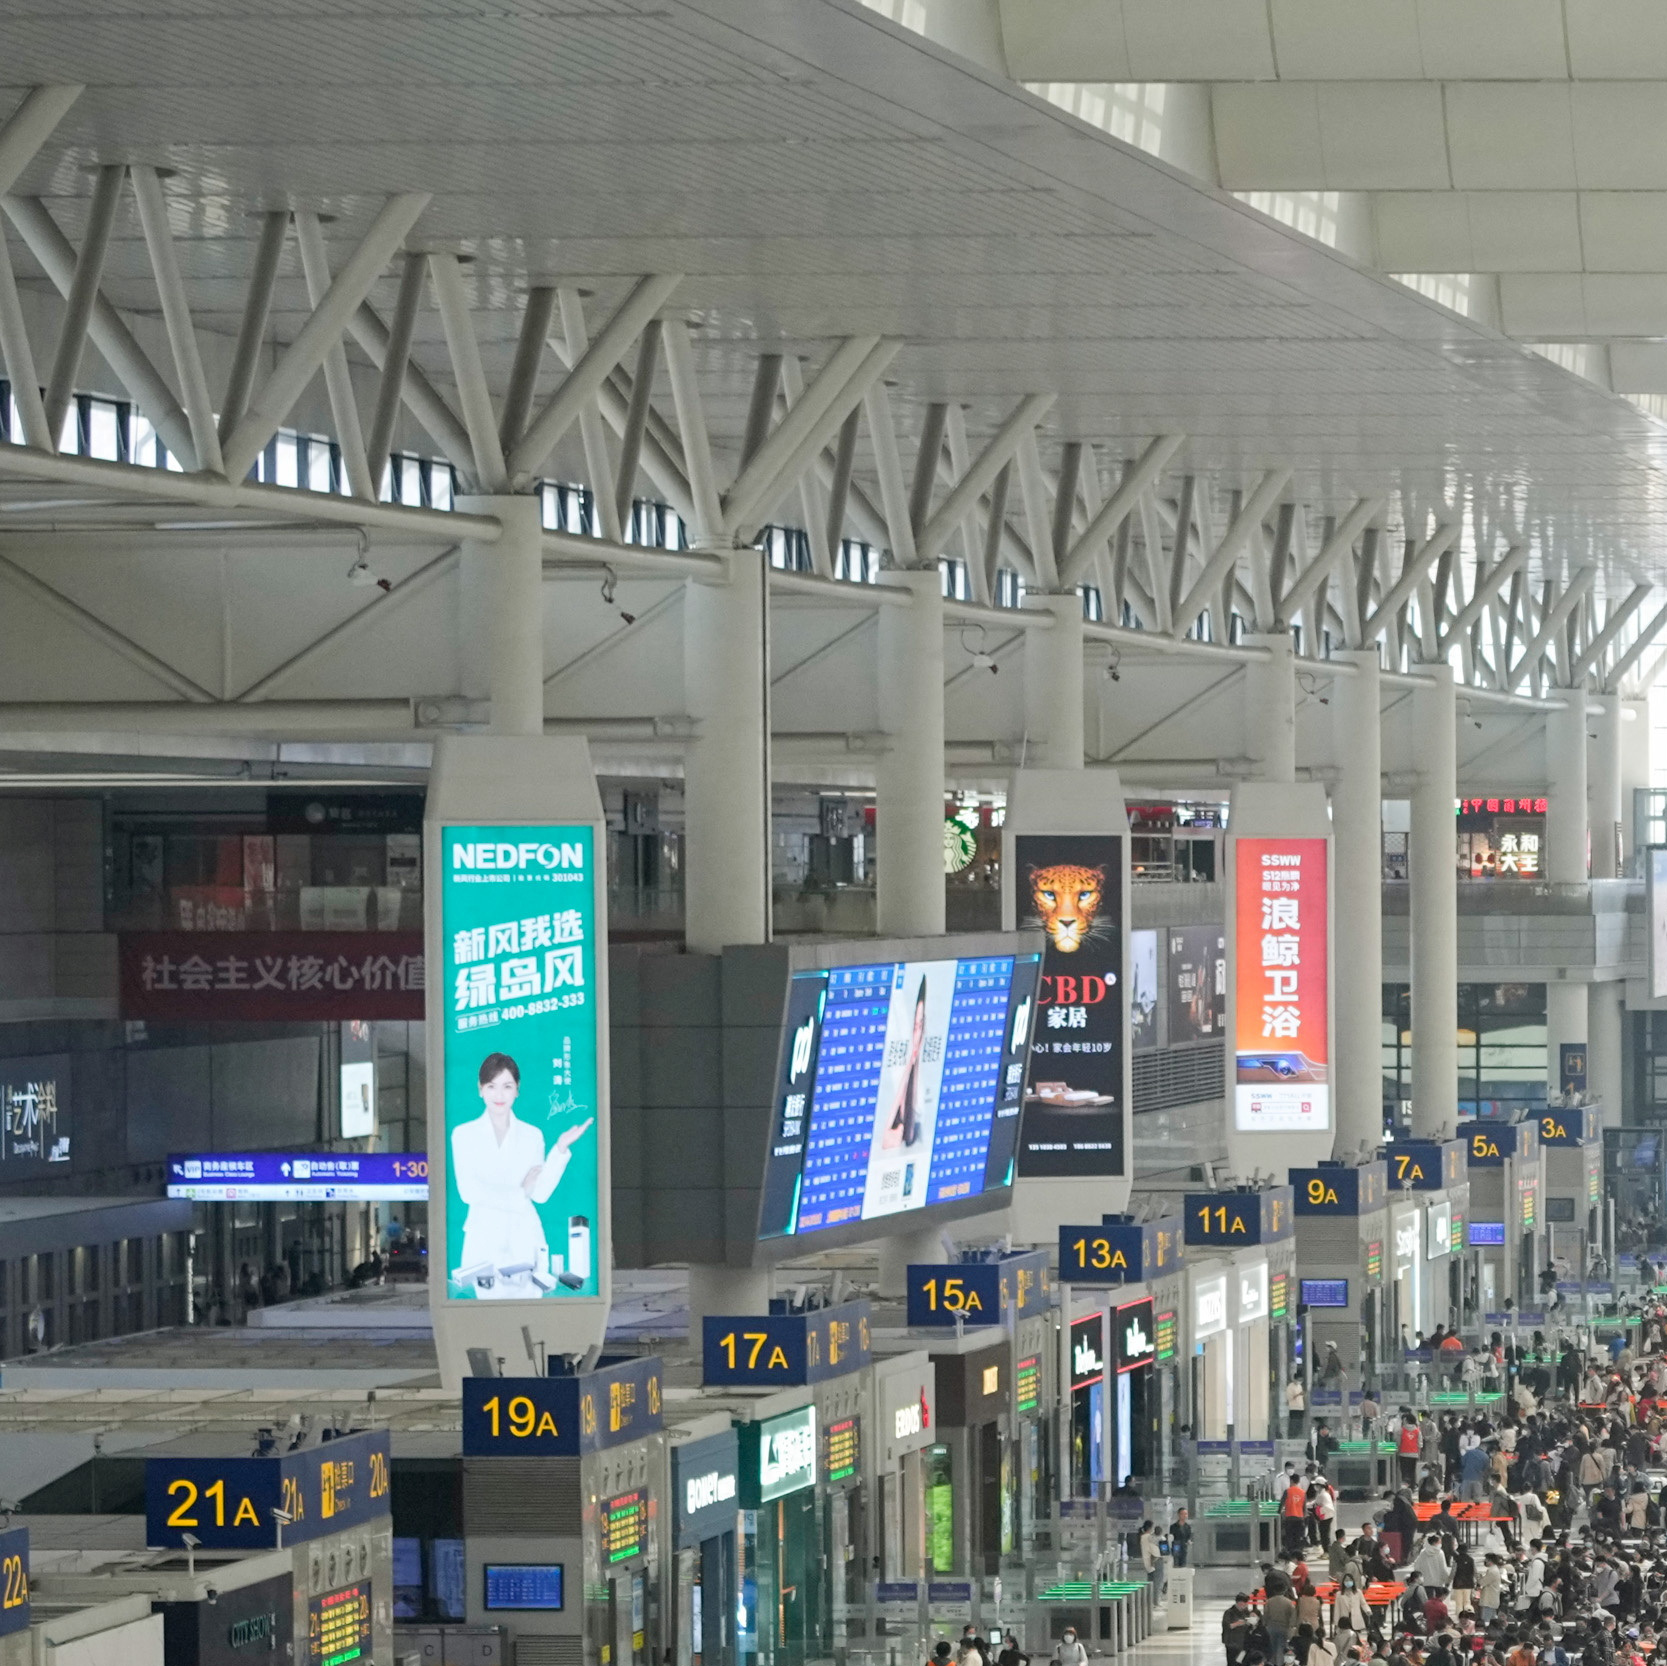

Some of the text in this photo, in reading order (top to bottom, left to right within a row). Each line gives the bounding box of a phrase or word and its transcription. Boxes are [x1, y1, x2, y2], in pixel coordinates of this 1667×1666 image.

[453, 843, 584, 869] NEDFON
[1501, 834, 1539, 852] 永和
[1261, 854, 1301, 867] SSWW
[1501, 854, 1539, 872] 大王
[552, 873, 584, 883] 301043
[453, 908, 584, 965] 新风我选
[454, 945, 585, 1011] 绿岛风
[1261, 896, 1301, 1038] 浪鲸卫浴
[501, 991, 585, 1021] 400-8832-333
[1047, 1007, 1088, 1029] 家居
[1541, 1117, 1567, 1138] 3A
[1472, 1135, 1500, 1157] 5A
[1394, 1155, 1424, 1180] 7A
[1307, 1179, 1339, 1204] 9A
[1198, 1206, 1247, 1234] 11A
[1073, 1238, 1128, 1269] 13A
[922, 1278, 983, 1311] 15A
[719, 1331, 789, 1371] 17A
[482, 1396, 559, 1438] 19A
[166, 1479, 261, 1530] 21A
